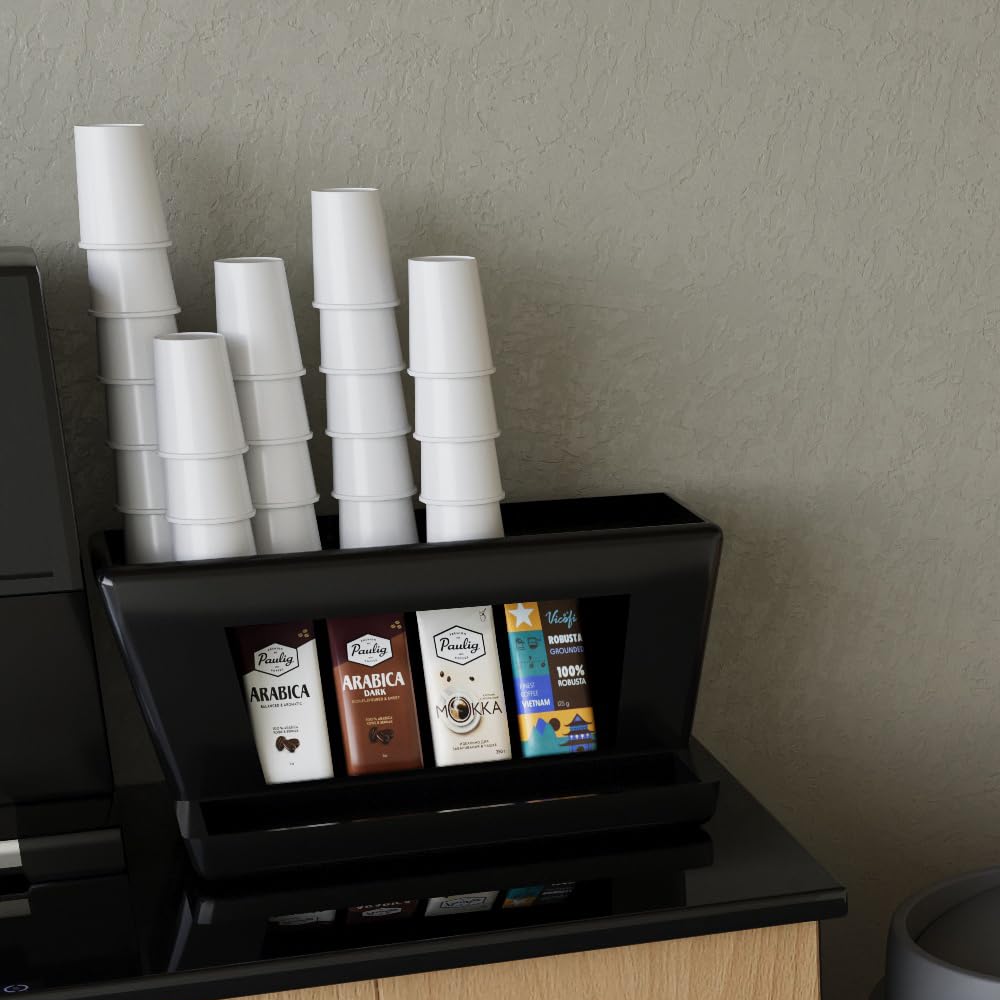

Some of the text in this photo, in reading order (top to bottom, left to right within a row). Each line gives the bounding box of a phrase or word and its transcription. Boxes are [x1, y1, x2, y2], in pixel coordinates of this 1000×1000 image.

[440, 638, 479, 653] Paulig
[548, 633, 583, 645] ROBUSTA
[351, 643, 387, 657] Paulig
[550, 646, 584, 655] GROUNDED
[258, 652, 294, 666] Paulig
[557, 664, 585, 678] 100%
[343, 672, 405, 691] ARABICA
[558, 678, 587, 687] ROBUSTA
[250, 684, 310, 702] ARABICA
[364, 688, 386, 697] DARK
[436, 696, 503, 723] MOKKA
[521, 698, 551, 708] VIETNAM
